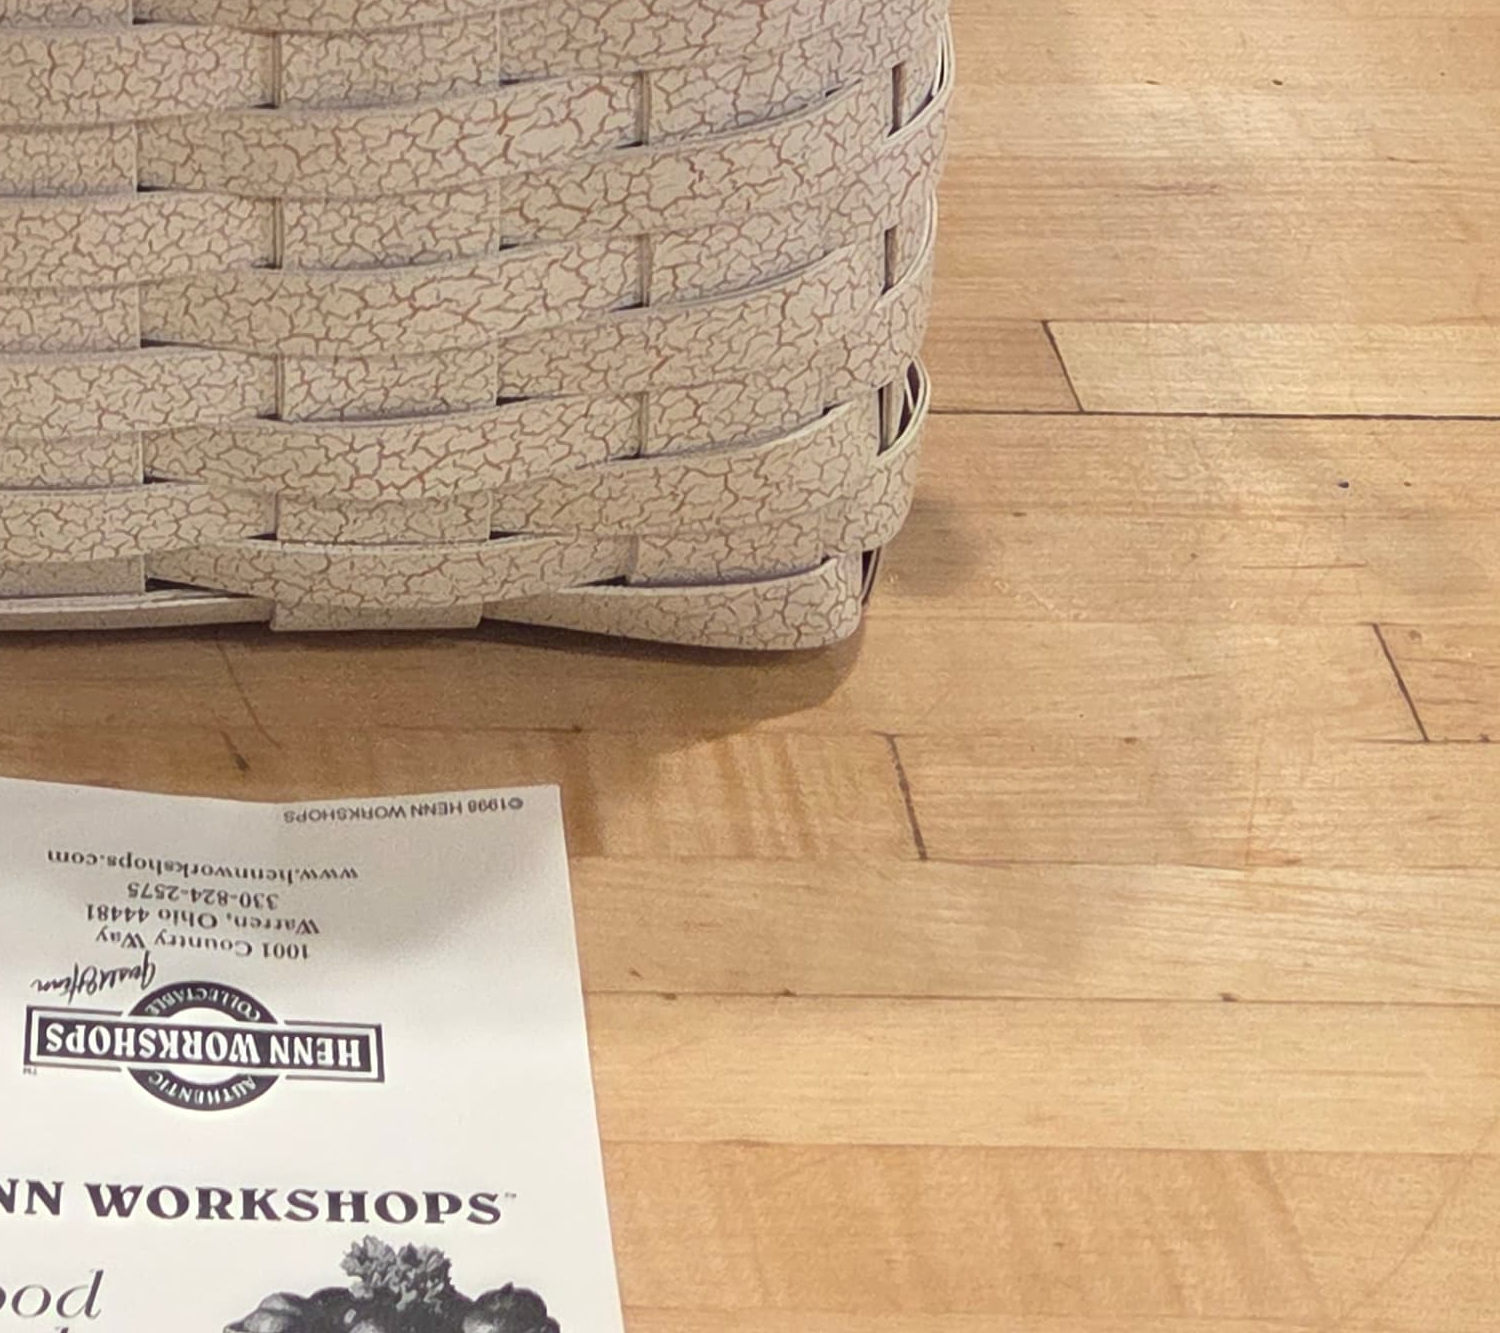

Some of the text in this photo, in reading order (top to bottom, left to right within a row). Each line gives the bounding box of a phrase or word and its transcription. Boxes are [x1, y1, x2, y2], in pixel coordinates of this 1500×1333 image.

[284, 805, 406, 824] WORKSHOPS
[410, 800, 463, 819] HENN
[47, 849, 359, 884] www.hennworkshops.com
[127, 882, 279, 909] 330-824-2575
[86, 903, 320, 935] Warren, Ohio 44481
[96, 925, 310, 960] 1001 Country Way
[145, 986, 261, 1023] COLLECTABLE
[46, 1022, 260, 1066] WORKSHOPS
[268, 1035, 362, 1068] HENN
[147, 1070, 258, 1105] AUTHENTIC
